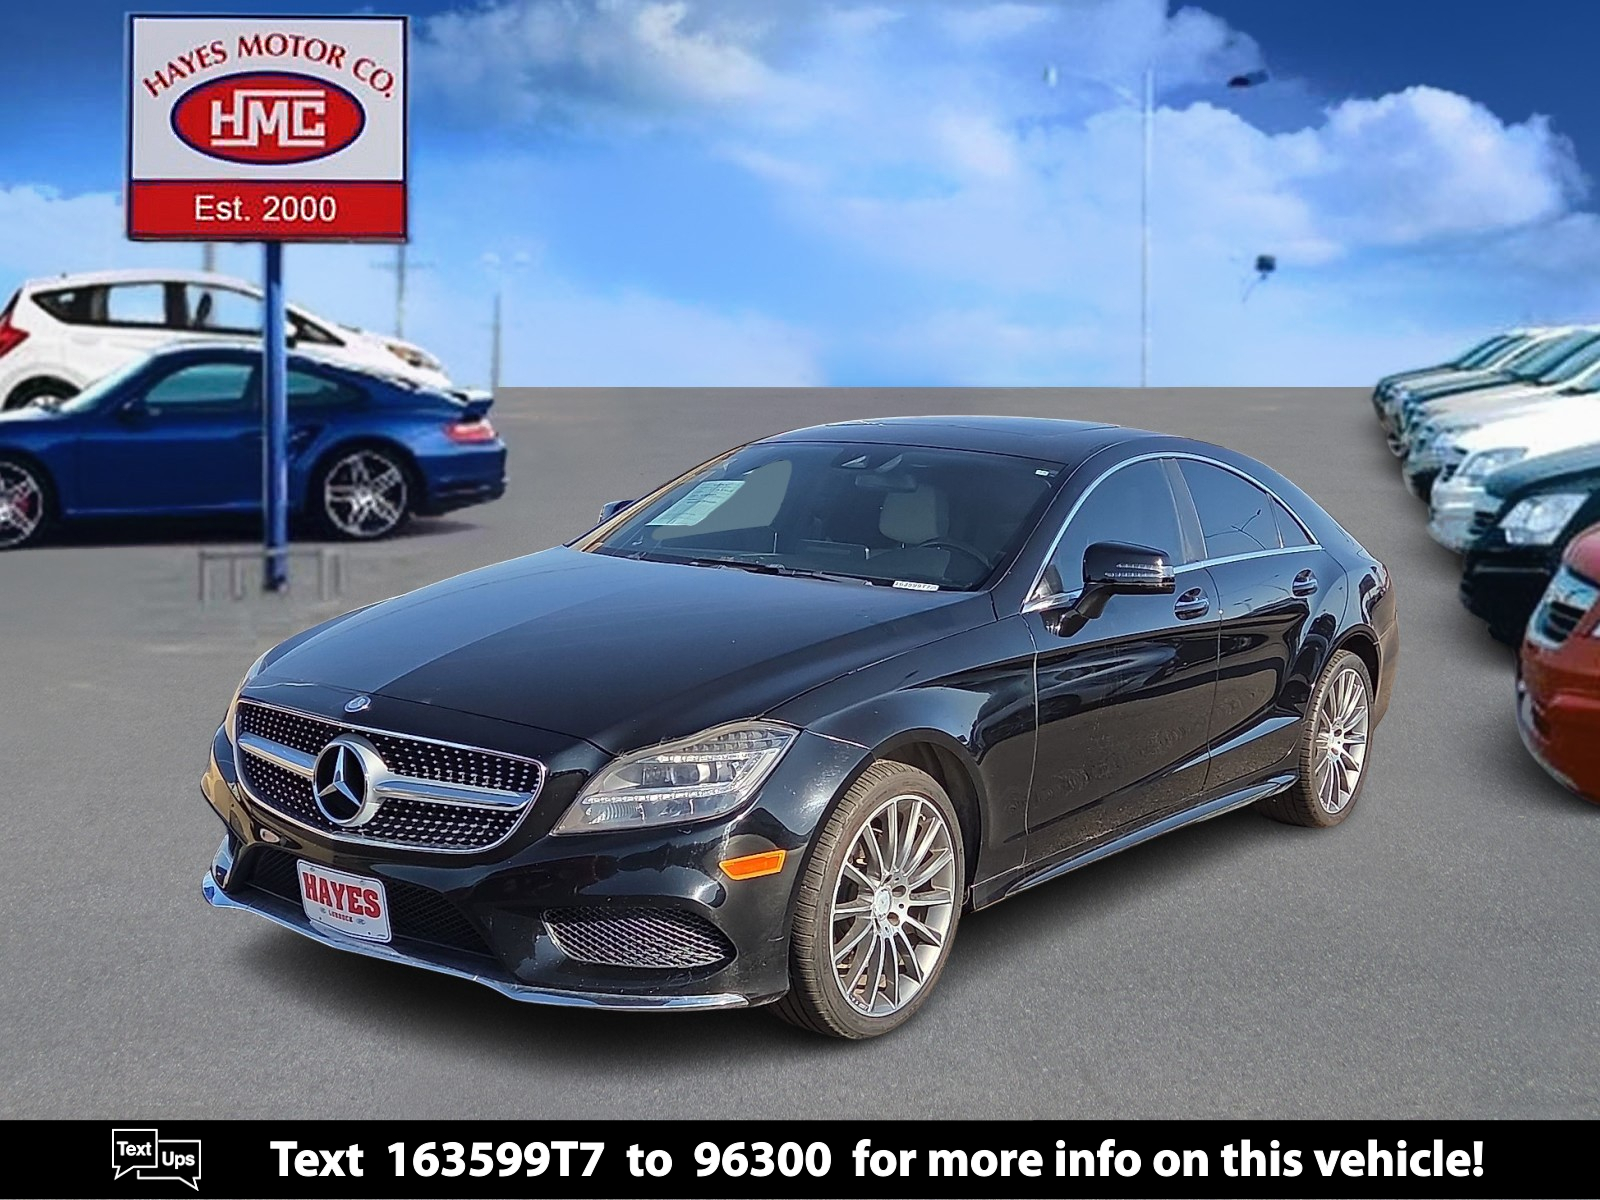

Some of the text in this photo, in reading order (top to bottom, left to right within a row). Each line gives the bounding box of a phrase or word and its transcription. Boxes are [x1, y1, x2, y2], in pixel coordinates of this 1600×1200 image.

[142, 33, 395, 99] HAYES MOTOR CO.
[210, 89, 326, 147] HMC
[195, 195, 337, 223] Est. 2000
[302, 872, 381, 918] HAYES
